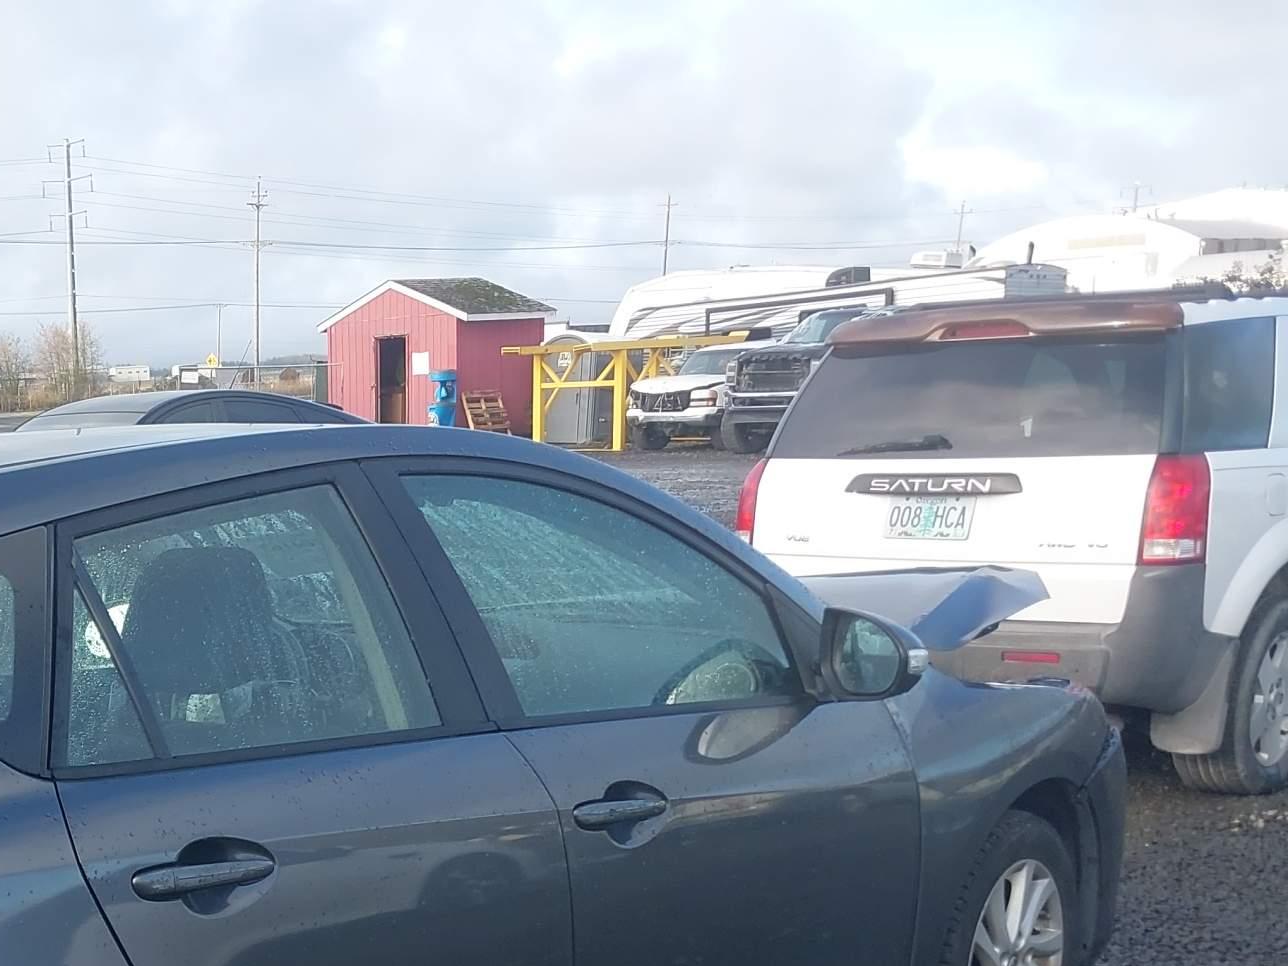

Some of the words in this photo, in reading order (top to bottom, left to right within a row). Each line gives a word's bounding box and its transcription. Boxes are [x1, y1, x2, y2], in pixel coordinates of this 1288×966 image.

[869, 478, 991, 493] SATURN
[889, 505, 923, 528] 008
[932, 505, 967, 529] HCA
